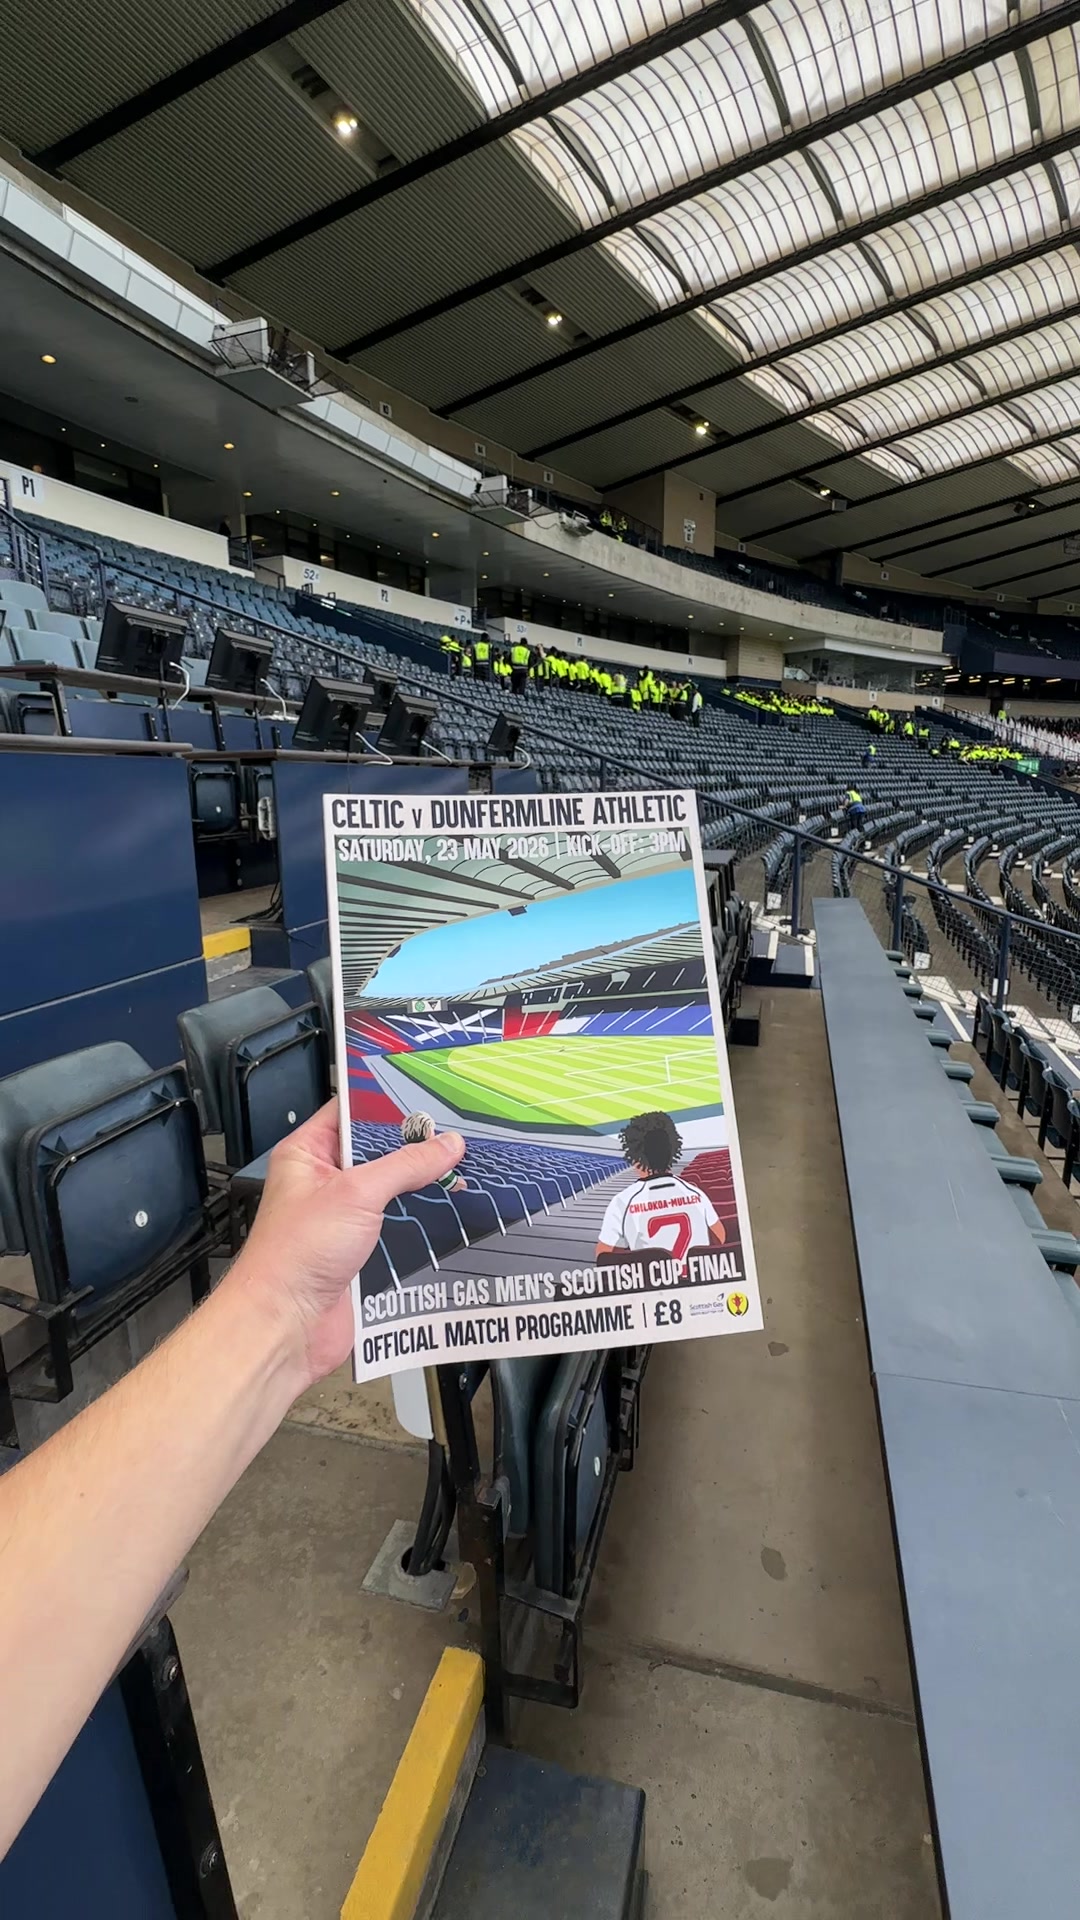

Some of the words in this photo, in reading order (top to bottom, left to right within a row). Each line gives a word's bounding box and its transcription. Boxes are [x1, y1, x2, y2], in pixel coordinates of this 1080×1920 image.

[22, 475, 36, 498] P1
[332, 799, 405, 829] CELTIC
[431, 797, 585, 829] DUNFERMLINE
[593, 795, 687, 825] ATHLETIC
[338, 838, 432, 865] SATURDAY,
[436, 838, 459, 862] 23
[463, 837, 501, 861] MAY
[506, 836, 550, 860] 2026
[566, 832, 645, 858] KICK-OFF:
[649, 830, 687, 854] 3PM
[364, 1281, 447, 1322] SCOTTISH
[453, 1278, 490, 1307] GAS
[495, 1271, 556, 1304] MEN'S
[560, 1262, 645, 1297] SCOTTISH
[649, 1258, 683, 1288] CUP
[688, 1252, 743, 1283] FINAL
[363, 1324, 439, 1364] OFFICIAL
[445, 1316, 509, 1348] MATCH
[515, 1304, 635, 1341] PROGRAMME
[654, 1298, 683, 1327] £8
